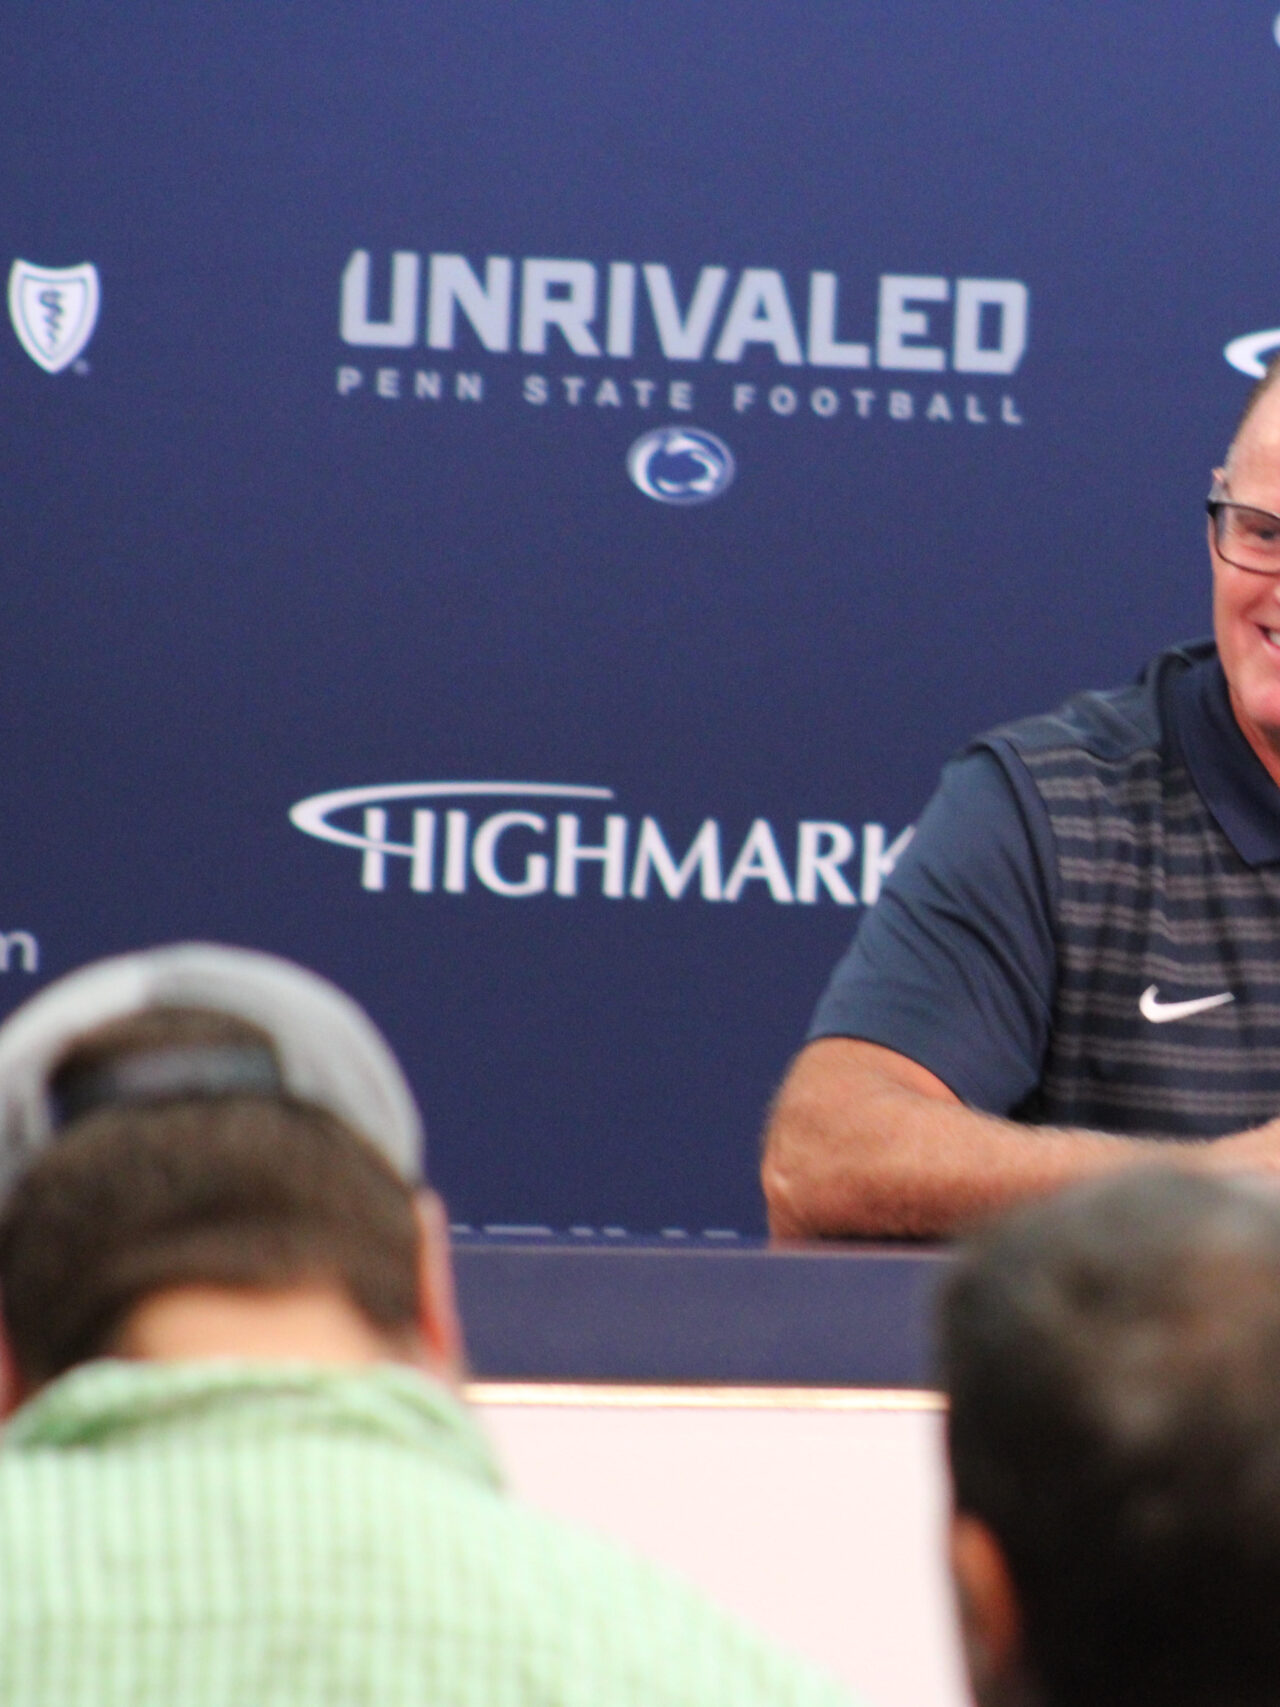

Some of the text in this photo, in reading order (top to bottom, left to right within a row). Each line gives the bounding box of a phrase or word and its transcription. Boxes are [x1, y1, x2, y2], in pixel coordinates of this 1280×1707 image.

[340, 249, 1028, 375] UNRIVALED
[336, 365, 1024, 425] PENN STATE FOOTBALL
[361, 807, 917, 905] HIGHMARK
